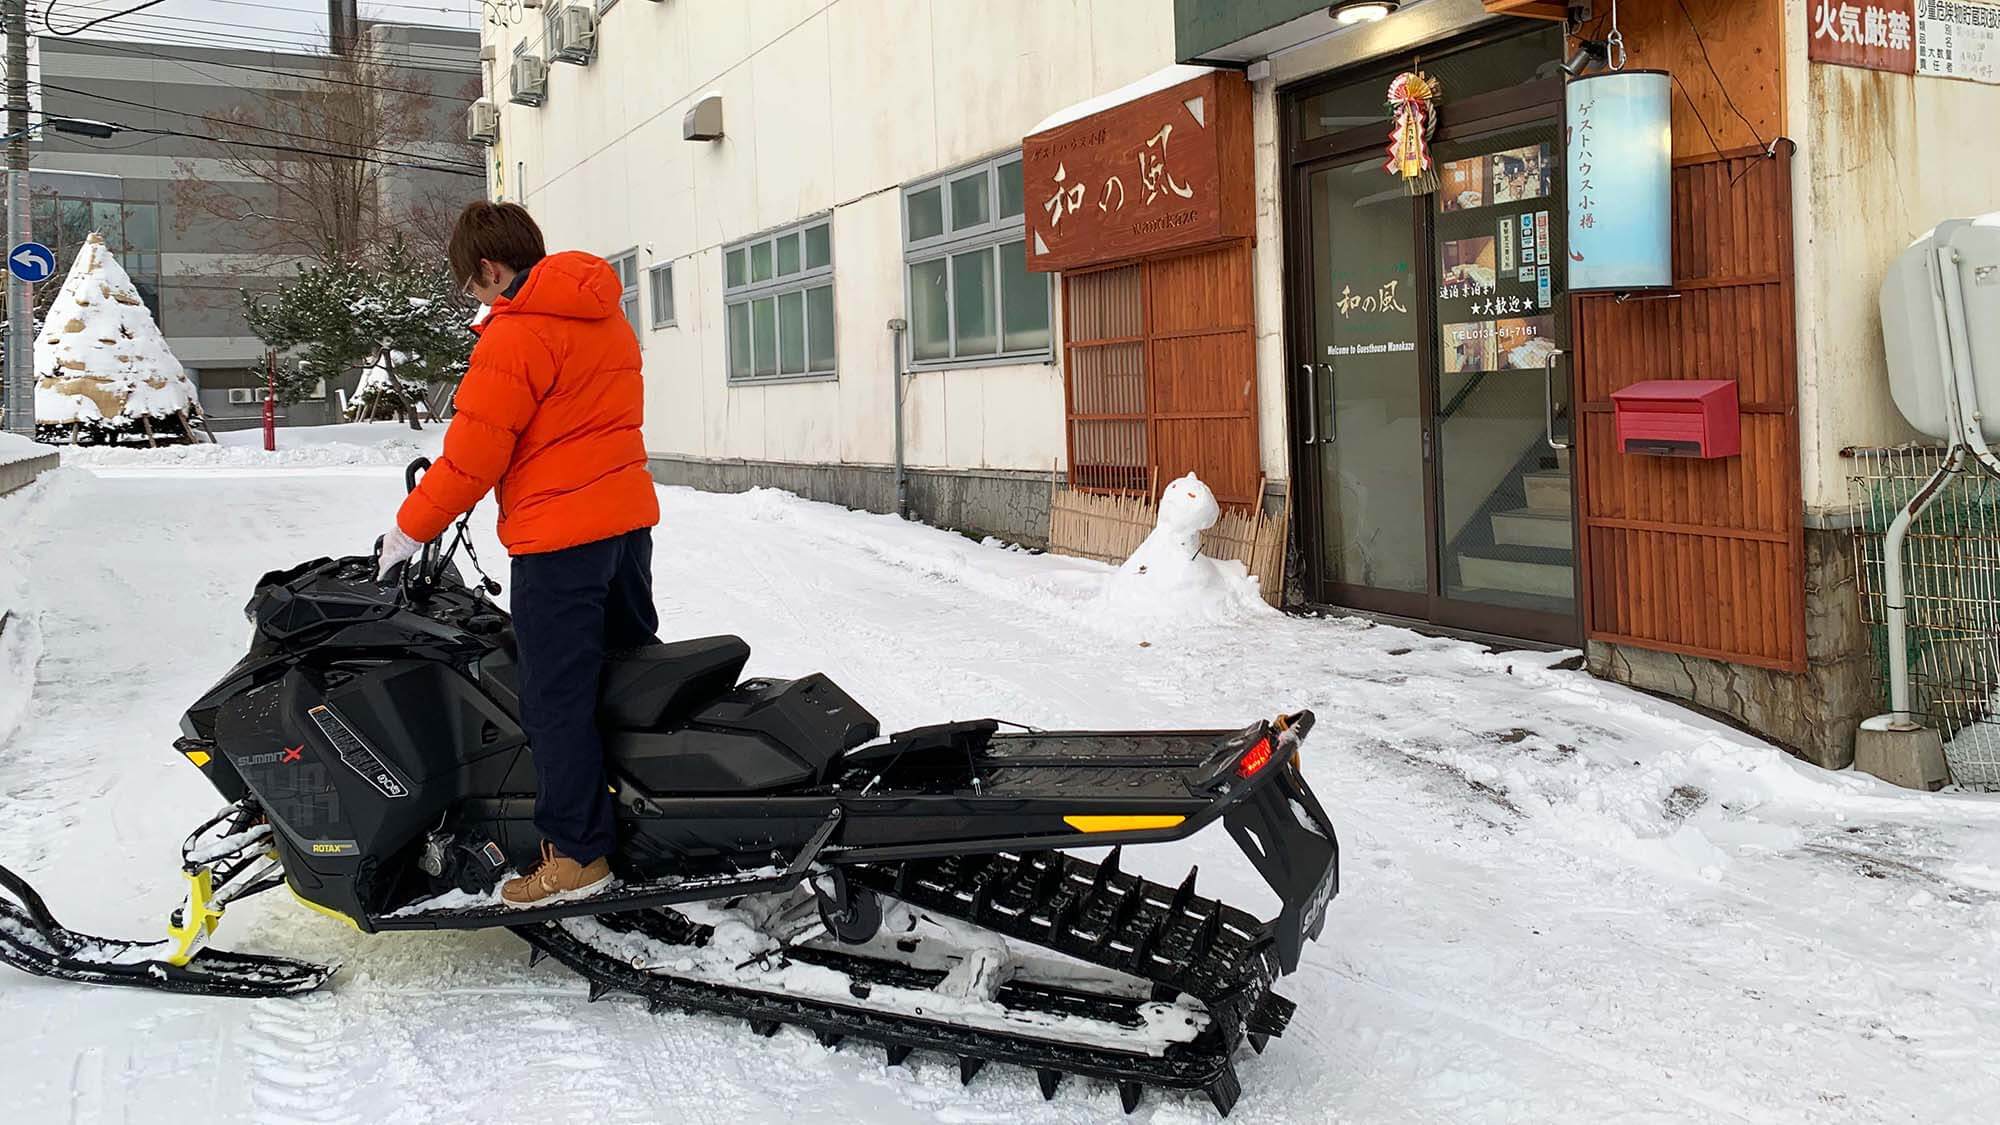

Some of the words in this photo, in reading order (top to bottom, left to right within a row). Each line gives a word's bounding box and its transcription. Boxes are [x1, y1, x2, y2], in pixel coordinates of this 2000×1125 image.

[1815, 0, 1911, 50] 火気厳禁
[1919, 0, 2000, 29] 少量危険物貯蔵取扱
[1043, 124, 1194, 237] 和の風
[1577, 100, 1596, 229] ゲストハウス小樽
[1336, 280, 1407, 319] 和の風
[1350, 345, 1356, 354] to
[313, 844, 341, 853] ROTAX
